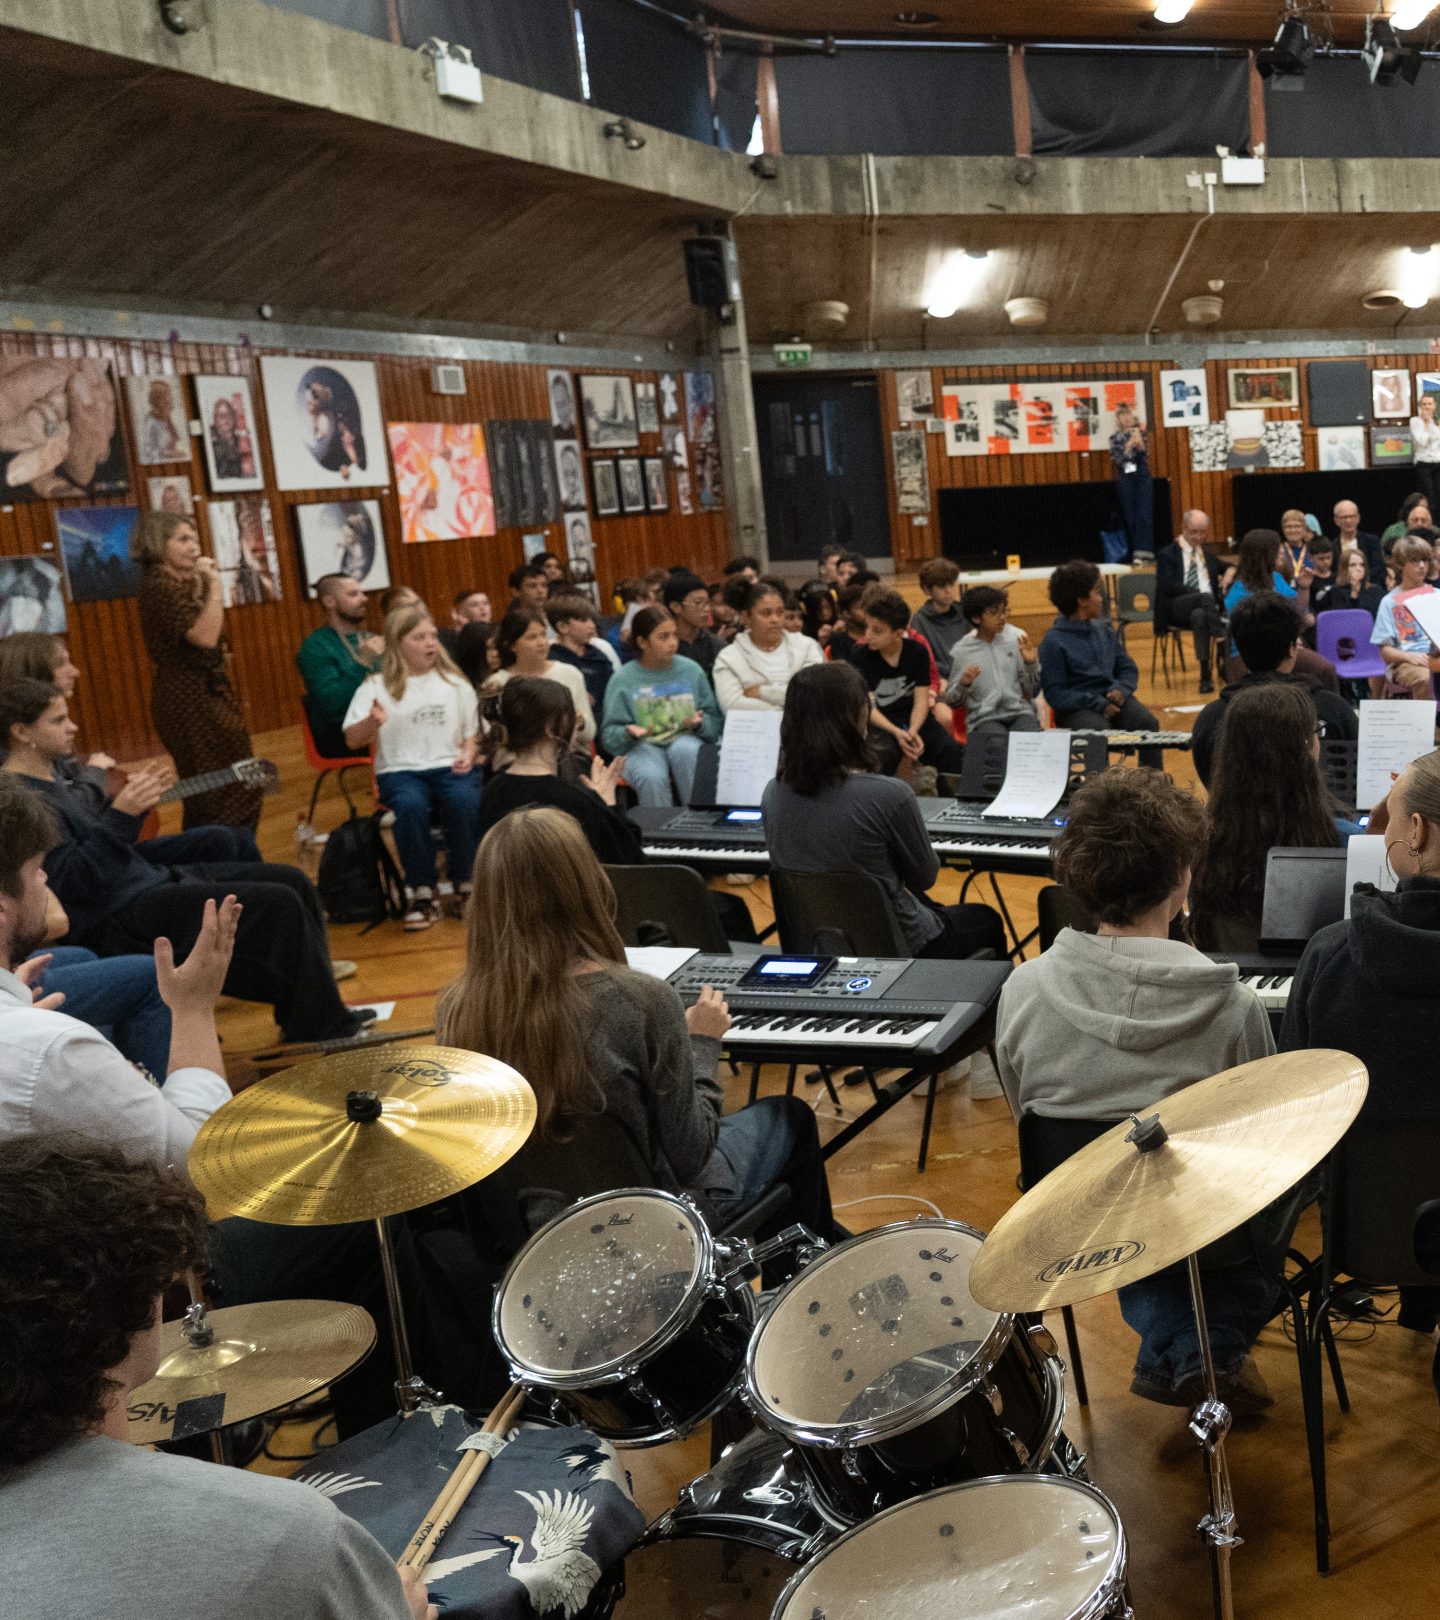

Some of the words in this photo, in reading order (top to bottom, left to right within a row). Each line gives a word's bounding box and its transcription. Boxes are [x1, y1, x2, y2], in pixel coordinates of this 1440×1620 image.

[380, 1063, 460, 1082] Solar
[606, 1212, 634, 1226] Pearl
[932, 1247, 960, 1263] Pearl
[1047, 1244, 1133, 1279] MAPEX
